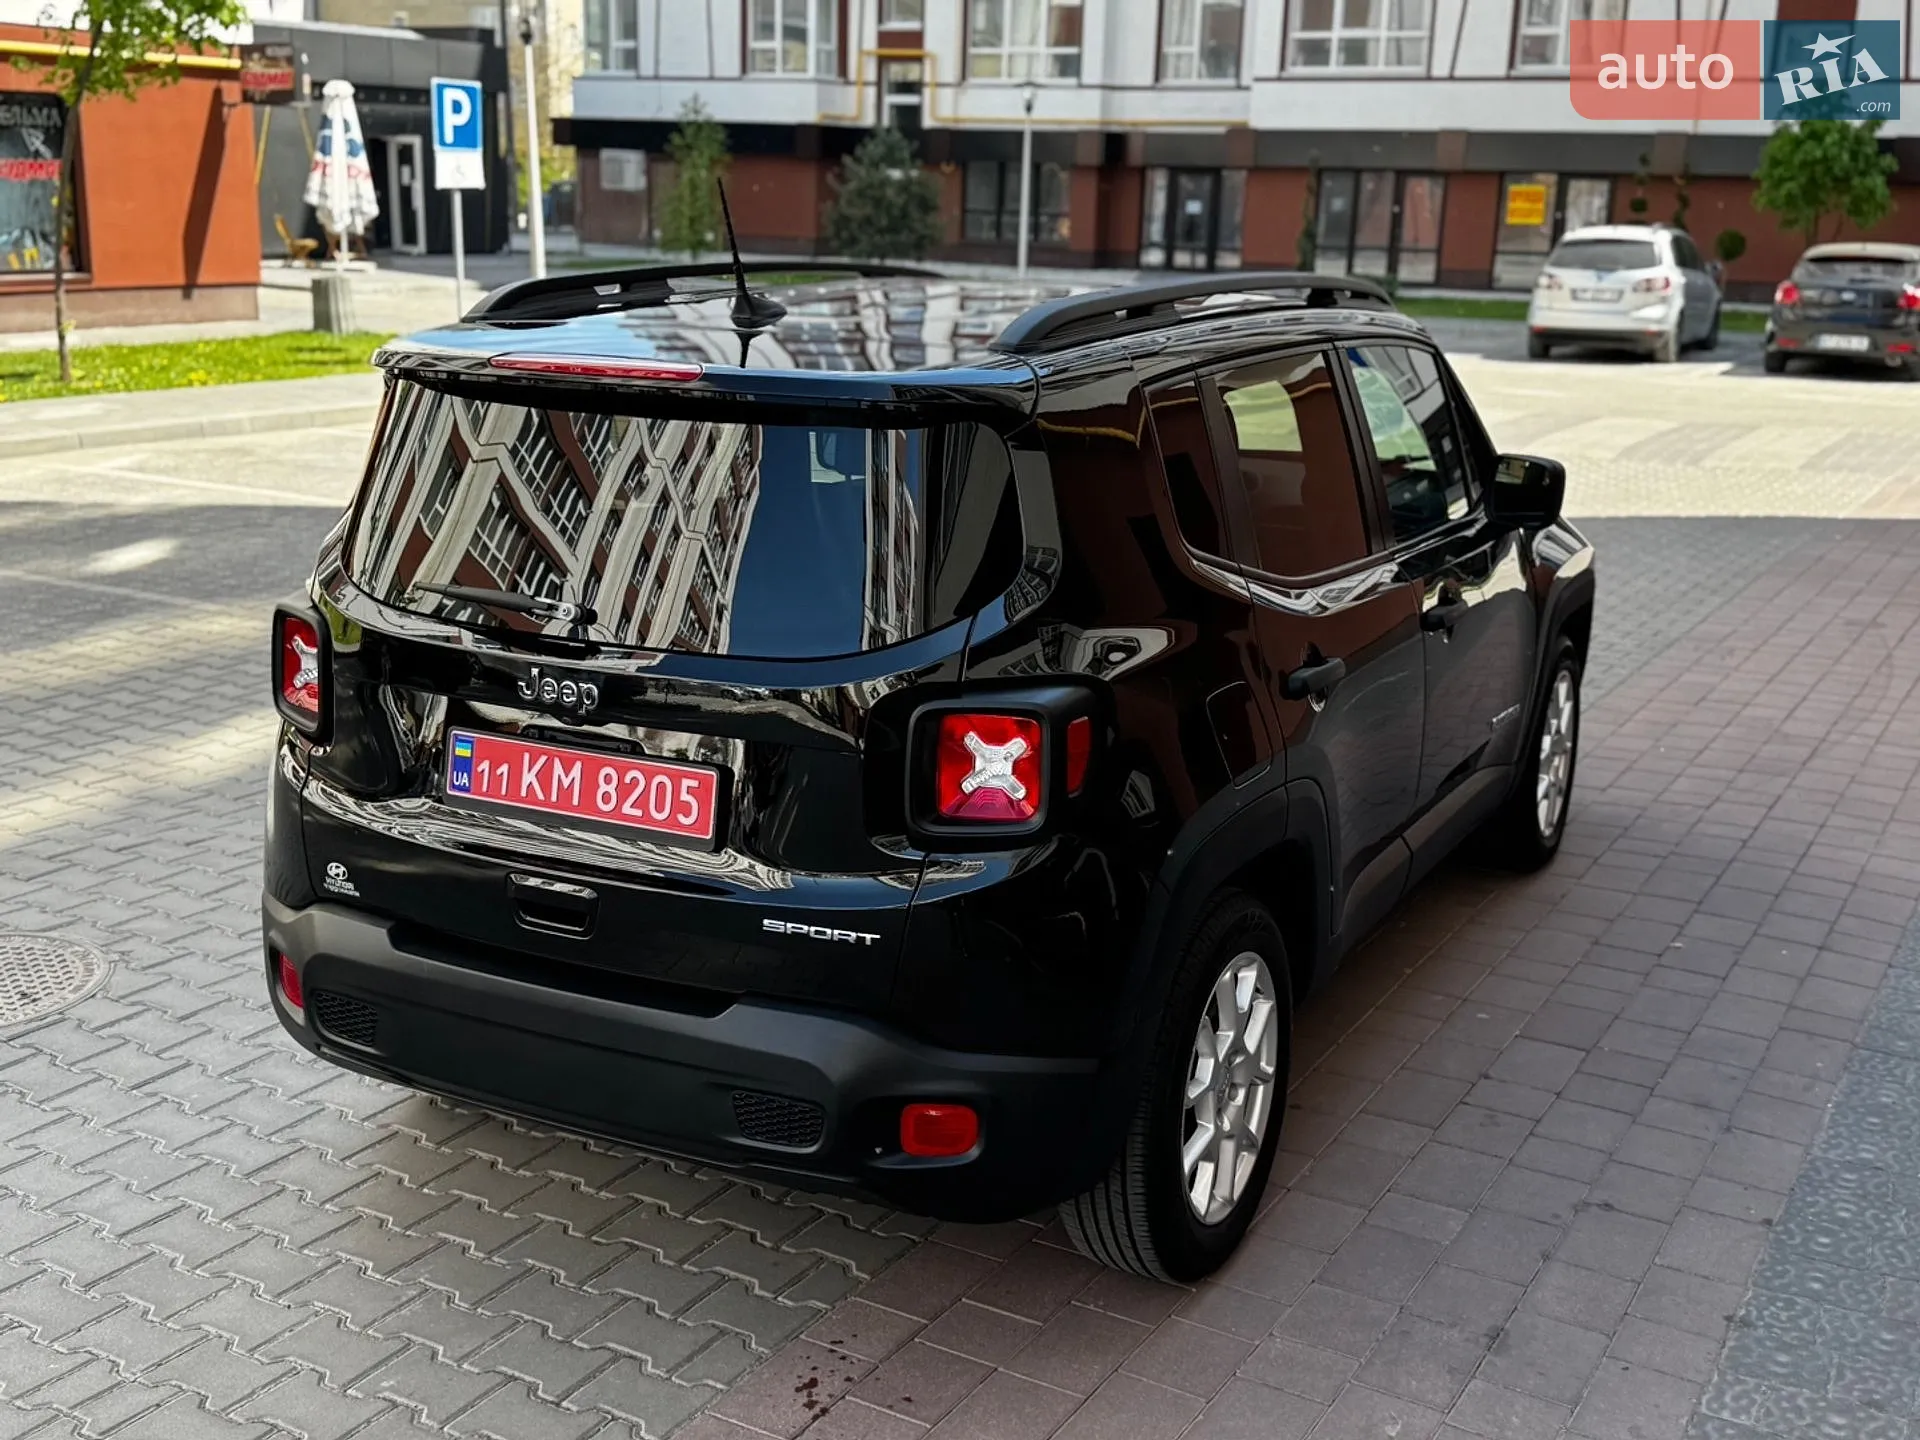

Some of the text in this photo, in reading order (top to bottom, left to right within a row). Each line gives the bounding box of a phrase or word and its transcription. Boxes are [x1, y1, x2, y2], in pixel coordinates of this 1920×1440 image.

[443, 87, 472, 145] P
[517, 667, 599, 714] Jeep
[453, 770, 470, 788] UA
[476, 751, 700, 826] 11 KM 8205
[762, 918, 881, 945] SPORT
